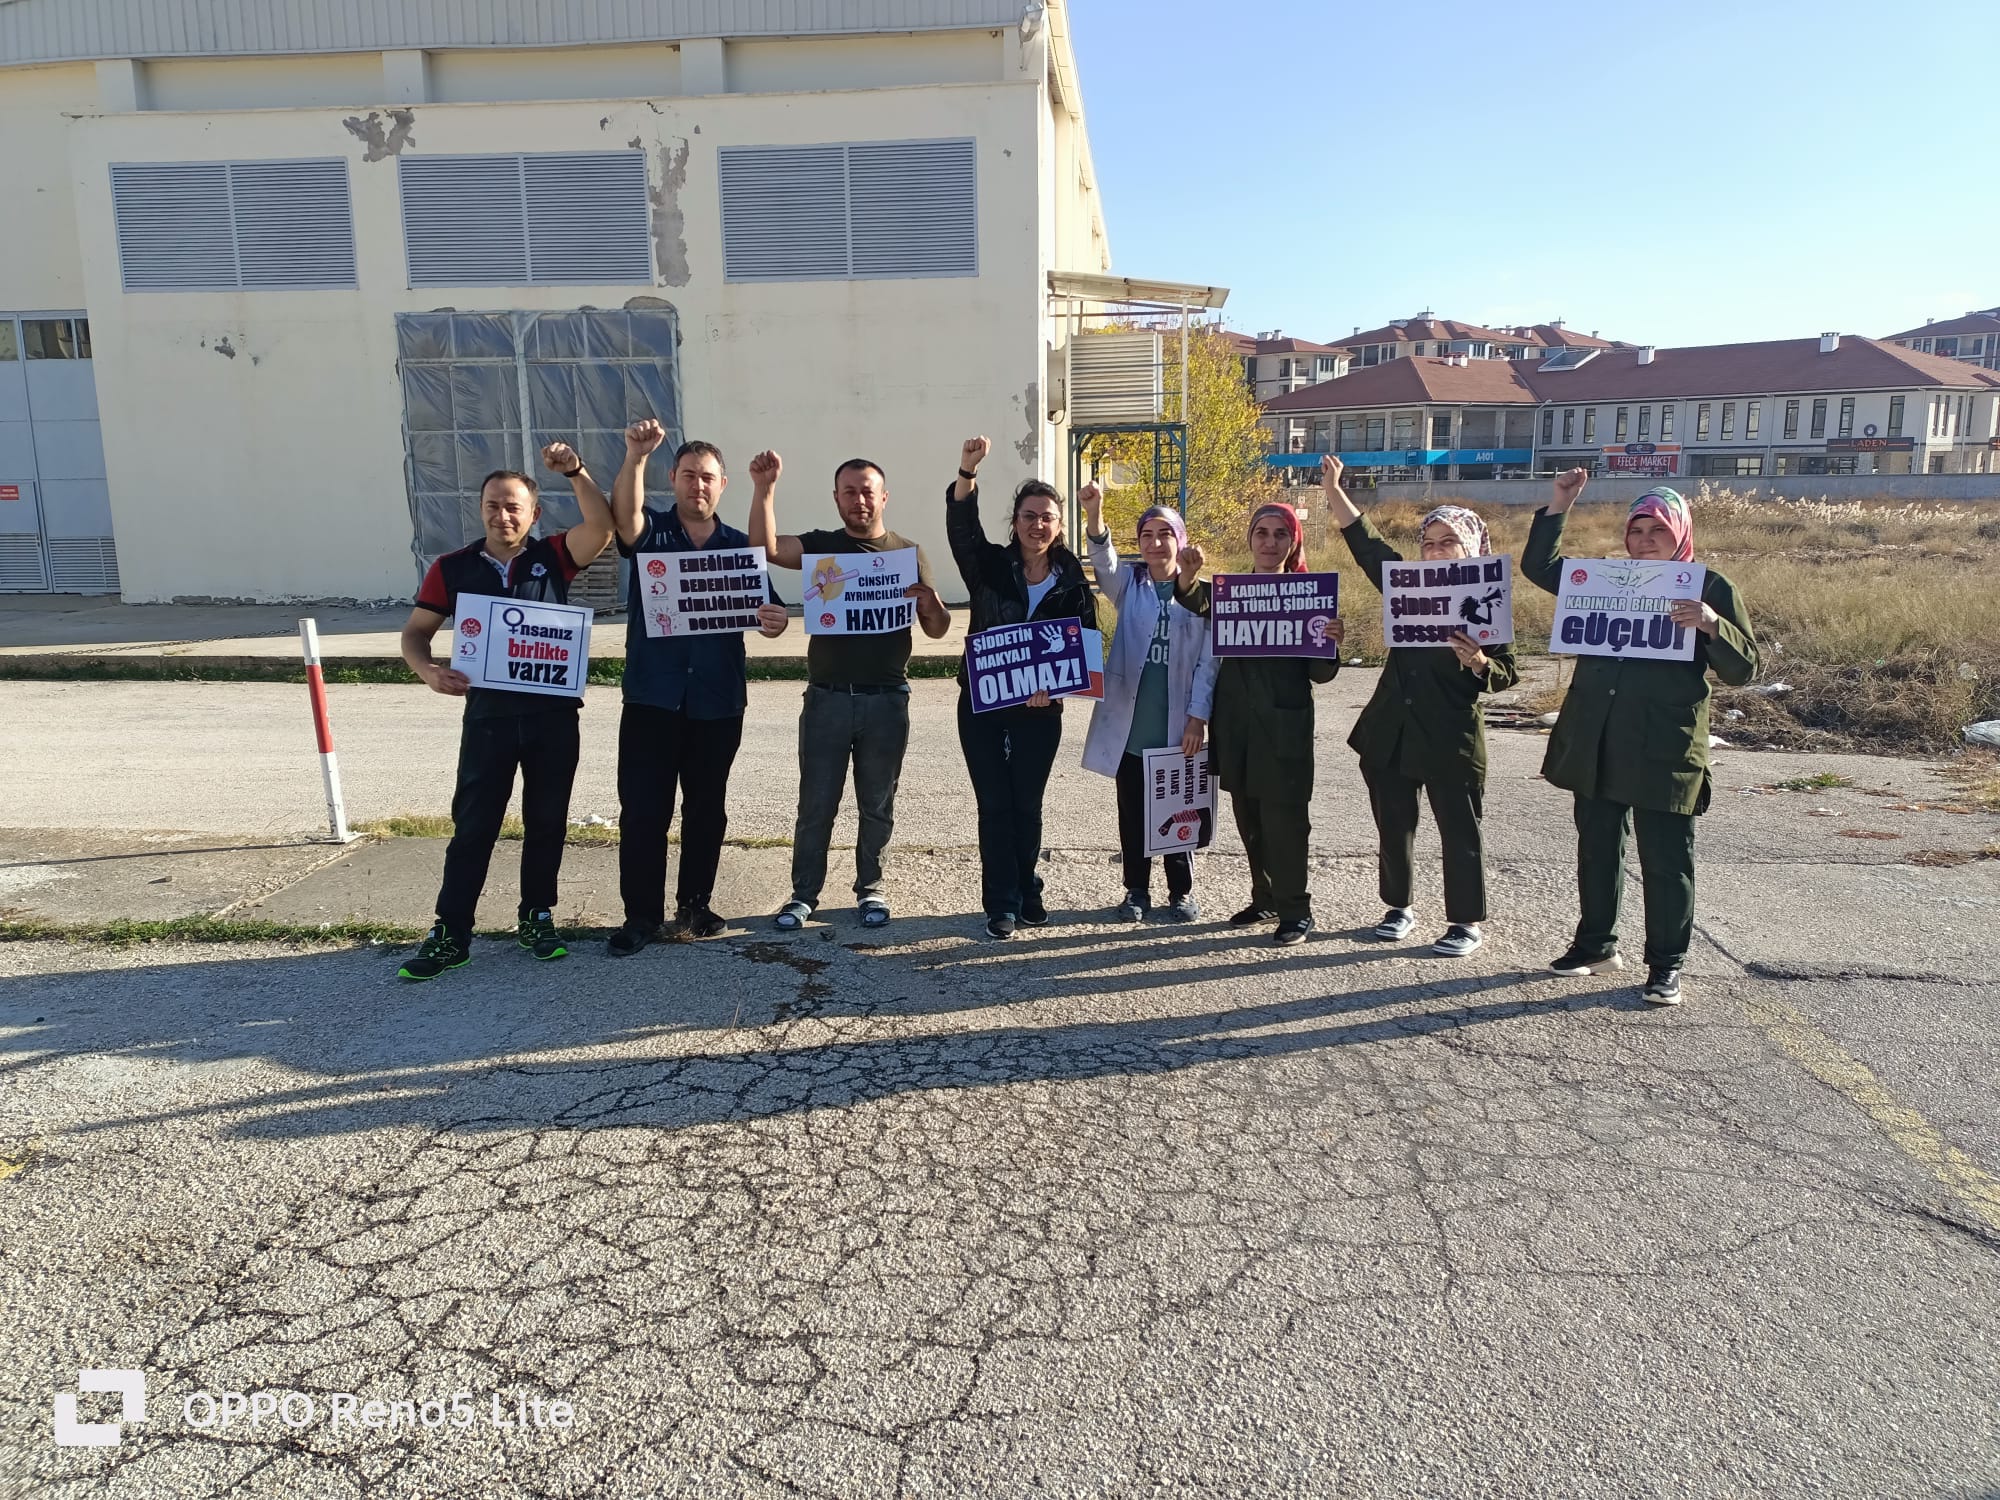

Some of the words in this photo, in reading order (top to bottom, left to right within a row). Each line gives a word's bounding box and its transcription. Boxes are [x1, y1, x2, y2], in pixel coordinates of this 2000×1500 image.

[1850, 439, 1887, 448] LADEN
[1640, 456, 1672, 467] MARKET
[858, 573, 900, 587] CİNSİYET
[1390, 568, 1420, 588] SEN
[1424, 563, 1480, 587] BAĞIR
[1484, 559, 1502, 582] Kİ
[845, 586, 909, 601] AYRIMCILIĞIN
[1230, 583, 1278, 598] KADINA
[1280, 580, 1318, 596] KARŞI
[1216, 601, 1240, 614] HER
[1242, 597, 1280, 613] TÜRLÜ
[1283, 596, 1334, 613] ŞİDDETE
[1391, 594, 1451, 619] ŞİDDET
[1565, 594, 1627, 611] KADINLAR
[845, 602, 913, 632] HAYIR!
[973, 627, 1033, 655] ŞİDDETİN
[1217, 620, 1304, 646] HAYIR!
[508, 638, 568, 661] birlikte
[975, 647, 1031, 671] MAKYAJI
[508, 661, 568, 686] varız
[978, 658, 1082, 704] OLMAZ!
[1156, 769, 1165, 785] 190
[1171, 769, 1180, 795] SAYILI
